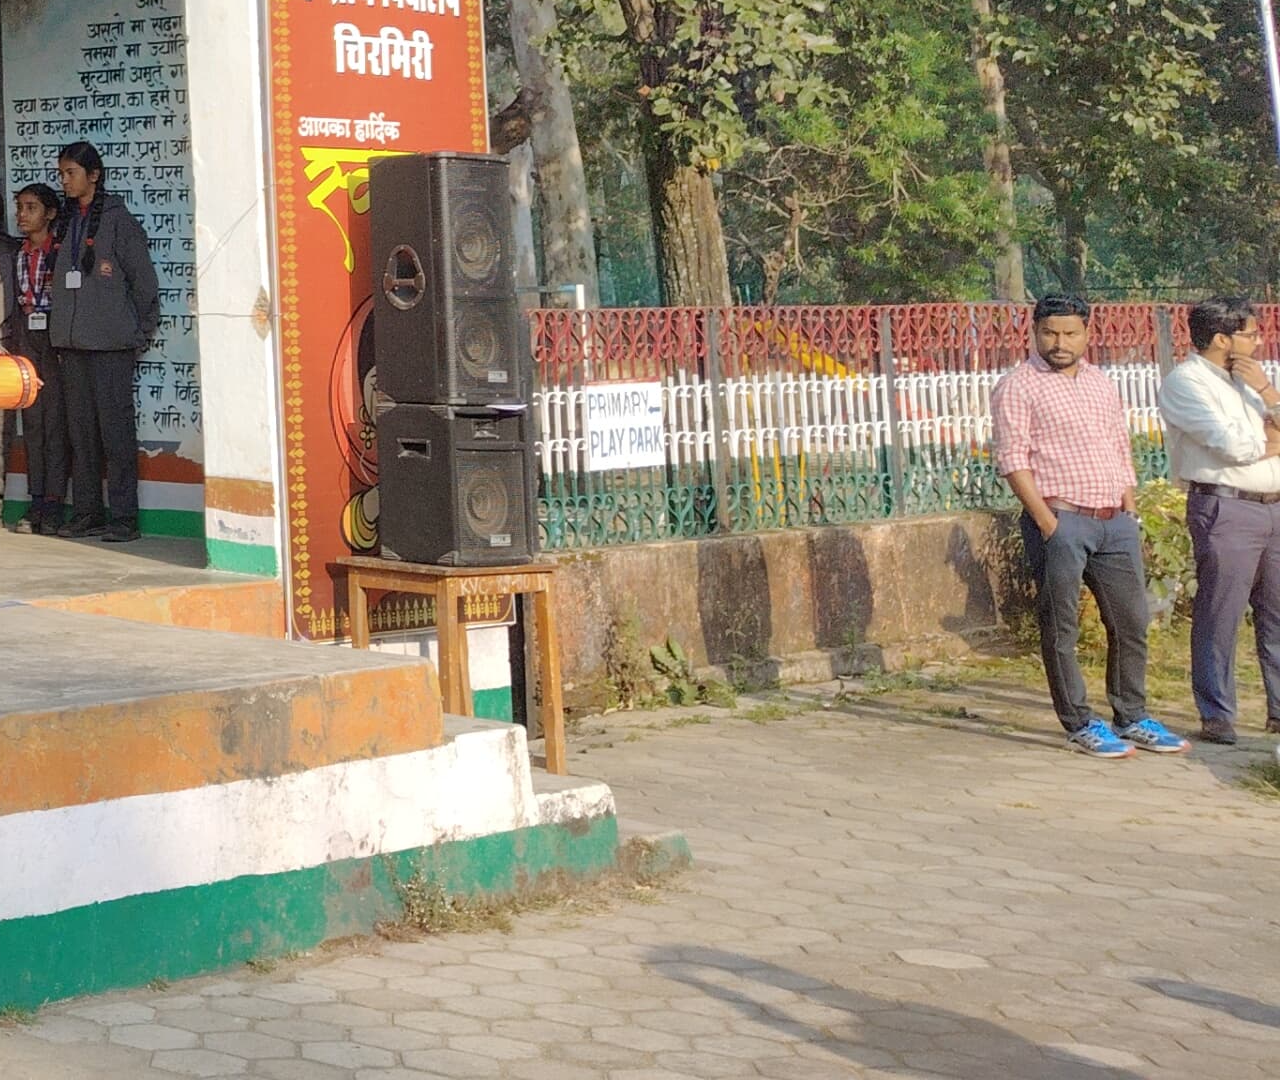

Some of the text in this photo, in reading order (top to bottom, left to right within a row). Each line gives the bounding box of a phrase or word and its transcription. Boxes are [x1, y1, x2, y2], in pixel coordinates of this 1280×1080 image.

[334, 23, 433, 81] चिरमिरी
[298, 112, 401, 144] आपका हार्दिक
[588, 390, 648, 419] PRIMARY
[590, 426, 663, 458] PLAY PARK
